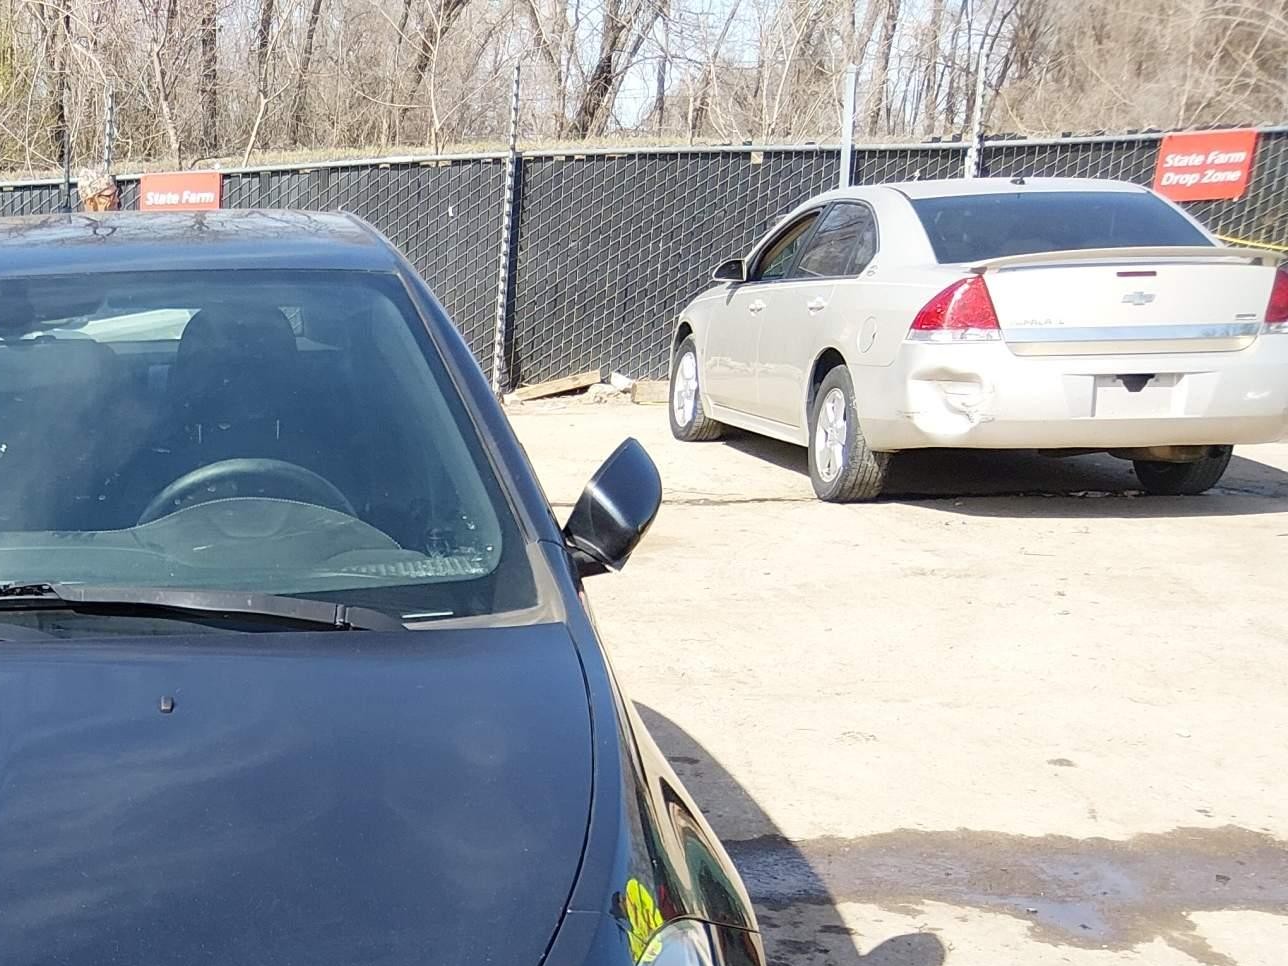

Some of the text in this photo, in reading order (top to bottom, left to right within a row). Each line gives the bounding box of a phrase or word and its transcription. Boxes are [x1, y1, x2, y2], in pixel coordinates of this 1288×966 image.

[1163, 151, 1247, 167] State Farm
[1161, 169, 1242, 187] Drop Zone
[146, 190, 214, 205] State Farm
